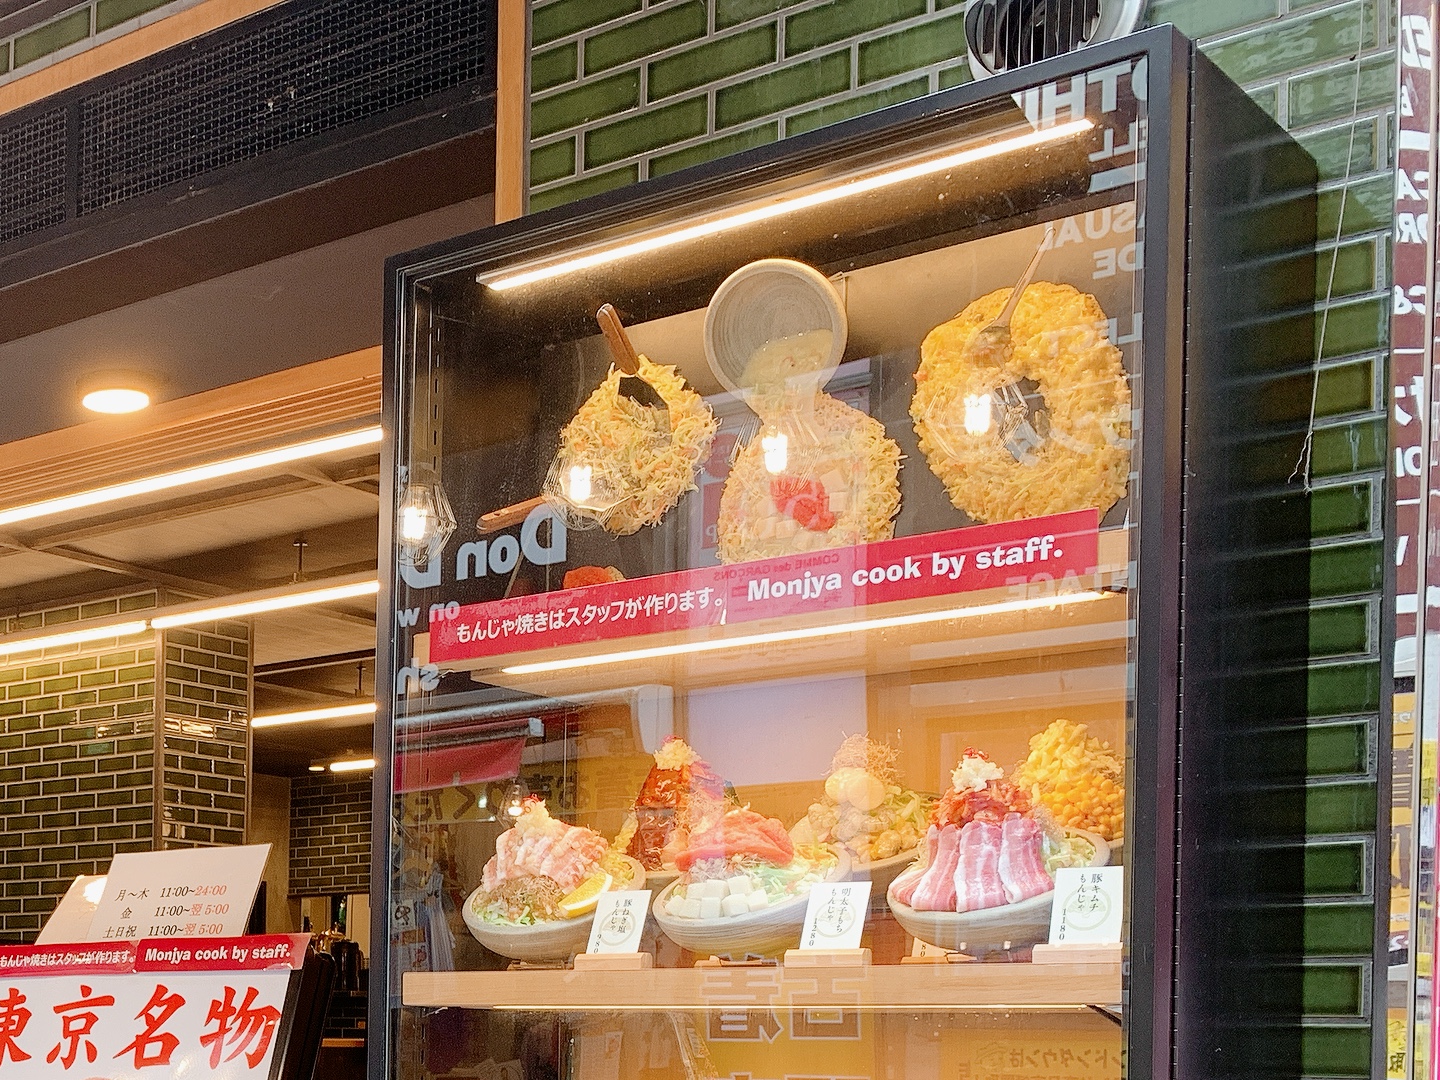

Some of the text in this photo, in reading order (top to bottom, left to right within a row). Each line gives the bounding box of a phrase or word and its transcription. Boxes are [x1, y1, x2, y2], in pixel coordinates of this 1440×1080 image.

[747, 535, 1064, 602] Monjya cook by staff.
[456, 586, 724, 644] もんじゃ焼きはスタッフが作ります。
[827, 888, 837, 921] もんじゃ
[1077, 873, 1087, 912] もんじゃ
[1089, 873, 1104, 912] 豚キムチ
[120, 907, 133, 919] 金
[610, 900, 620, 931] もんじゃ
[836, 887, 852, 933] 明太子もち
[1058, 908, 1067, 941] 1180
[103, 925, 137, 939] 土日祝
[593, 934, 602, 954] 980
[808, 917, 818, 947] 1280
[0, 949, 136, 969] もんじゃ焼きはスタッフが作ります。
[145, 943, 291, 965] Monjya cook by staff.
